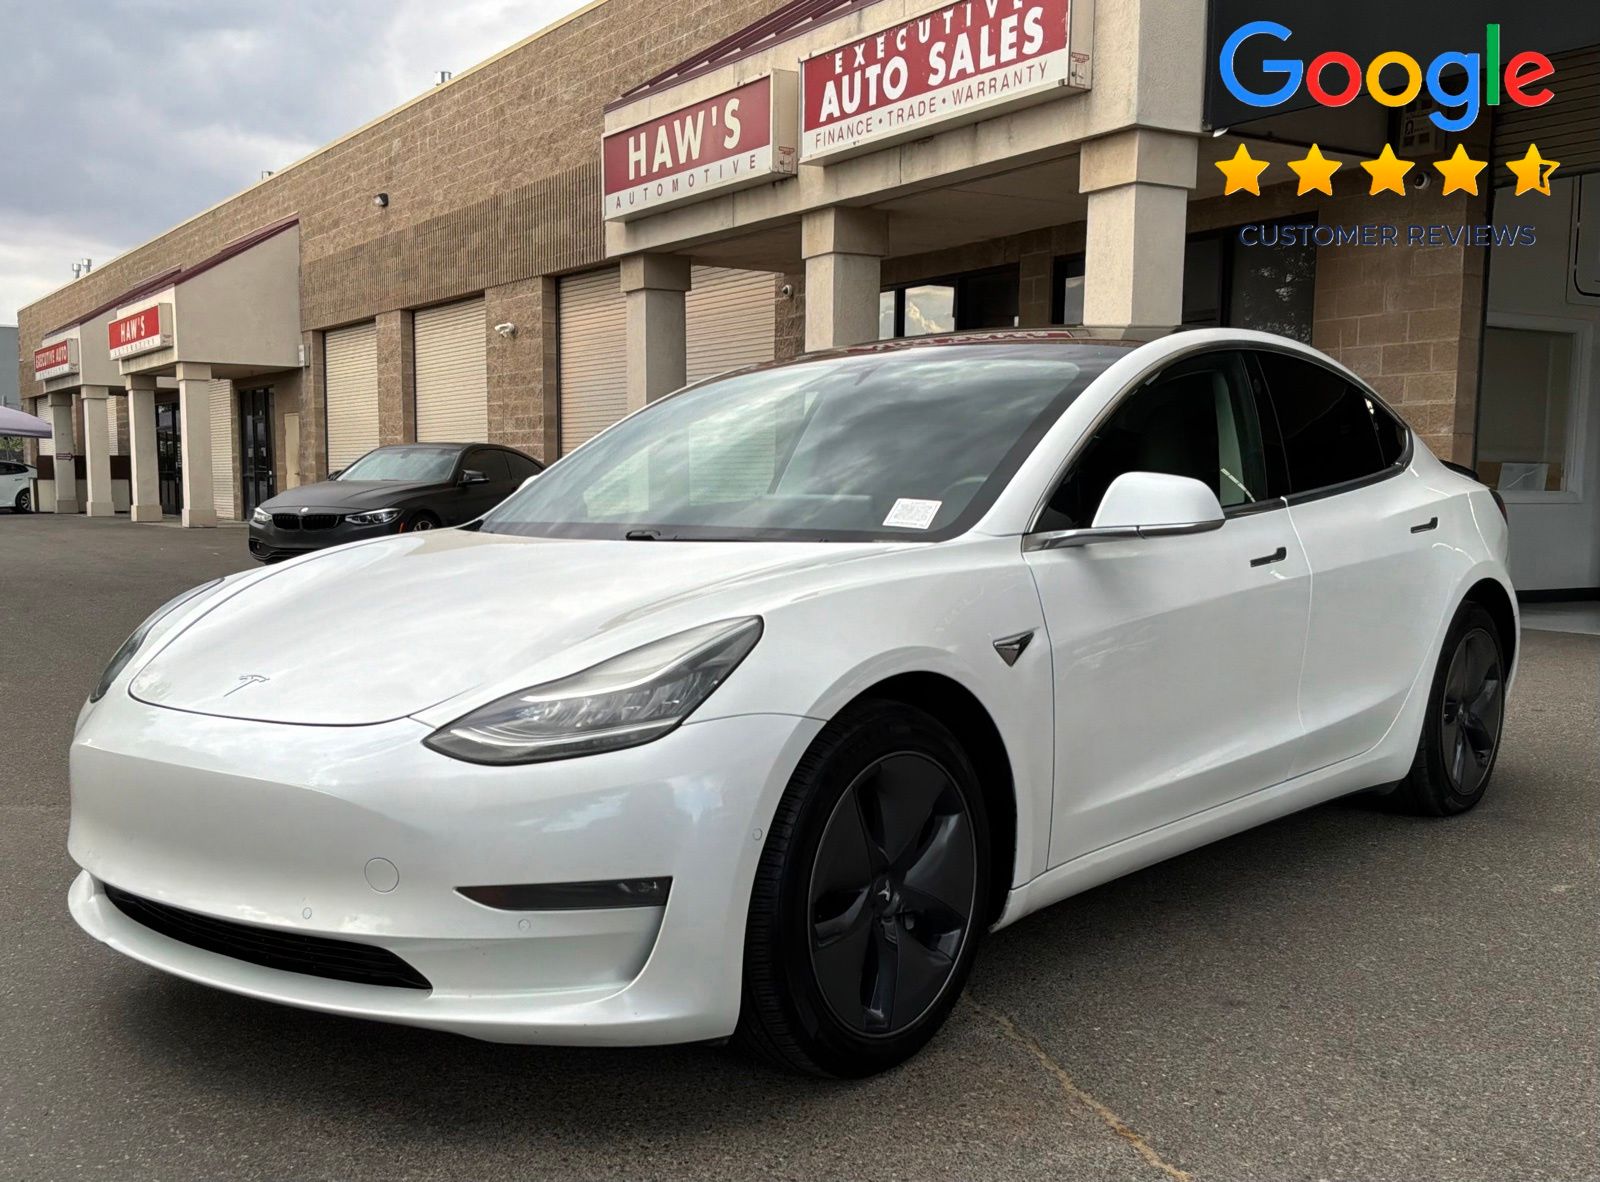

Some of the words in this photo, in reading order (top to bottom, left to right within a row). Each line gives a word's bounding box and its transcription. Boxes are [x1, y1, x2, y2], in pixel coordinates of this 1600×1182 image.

[815, 118, 873, 148] FINANCE
[887, 96, 937, 127] TRADE
[952, 61, 1048, 106] WARRANTY
[819, 56, 908, 123] AUTO
[927, 6, 1043, 87] SALES
[628, 98, 741, 181] HAW'S
[616, 154, 756, 209] AUTOMOTIVE
[120, 315, 145, 343] HAW'S
